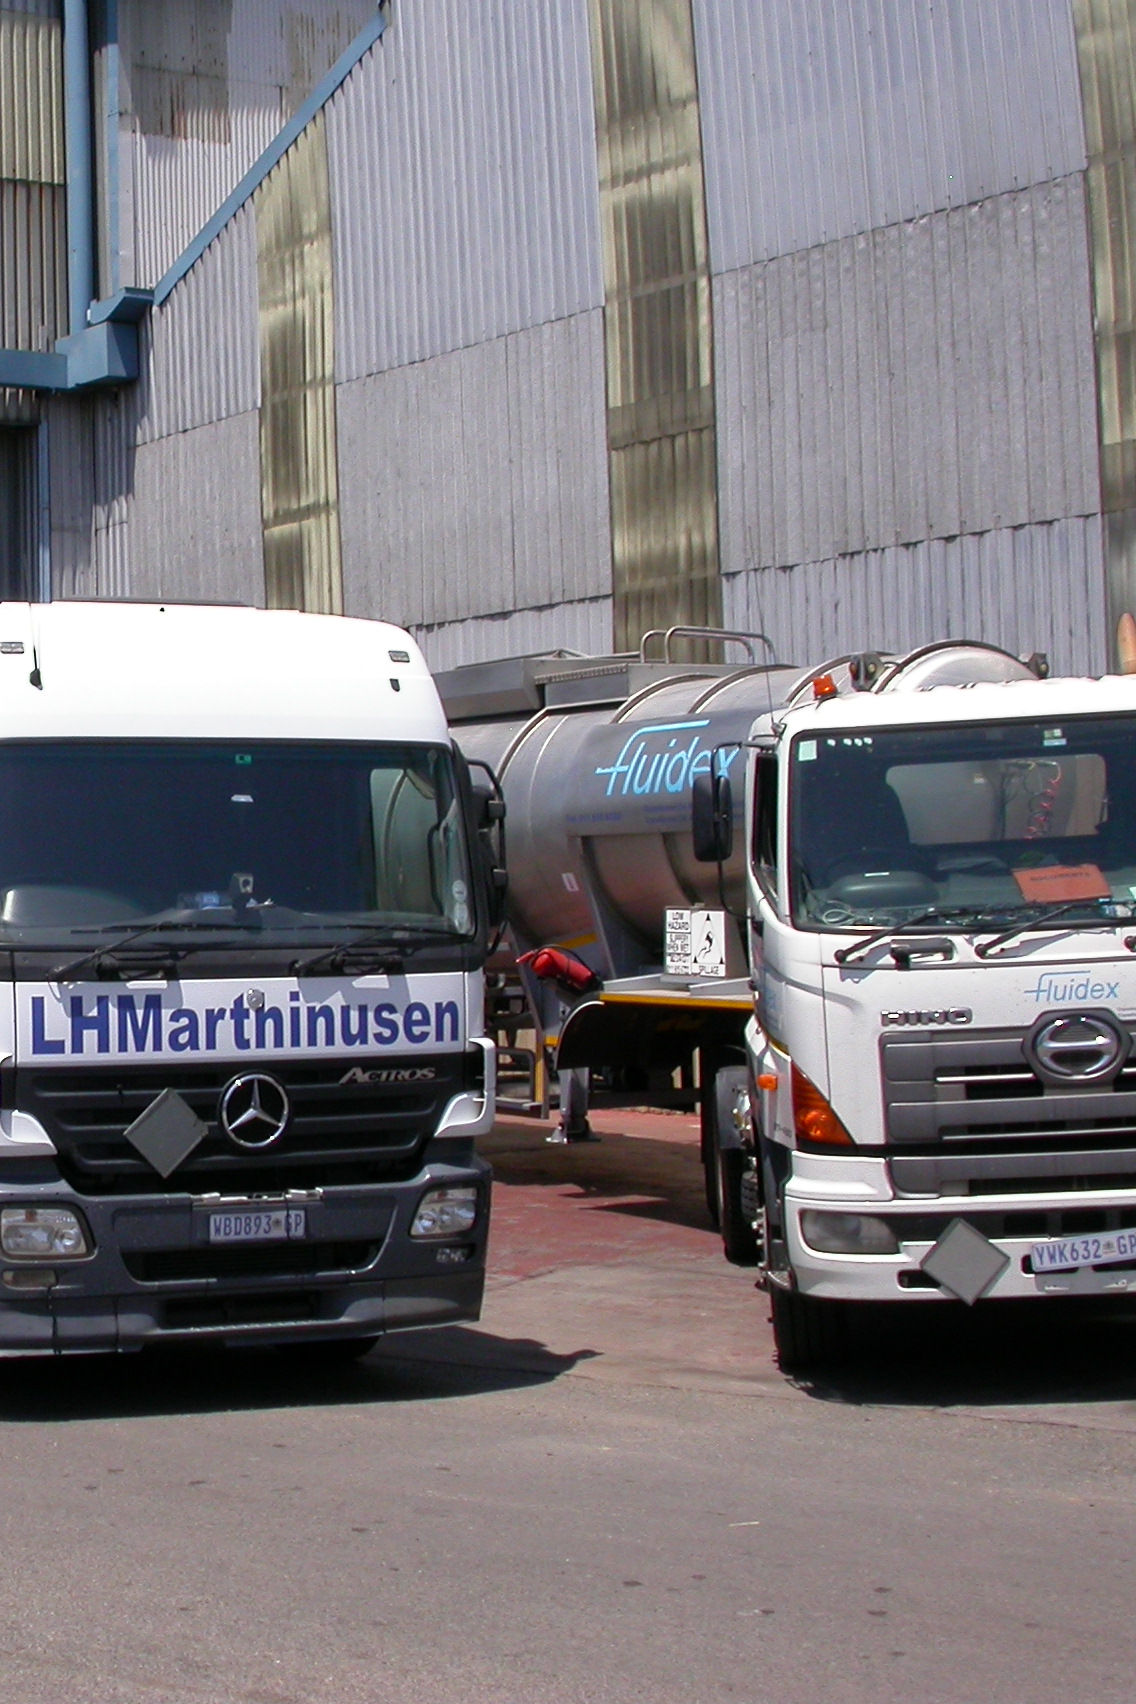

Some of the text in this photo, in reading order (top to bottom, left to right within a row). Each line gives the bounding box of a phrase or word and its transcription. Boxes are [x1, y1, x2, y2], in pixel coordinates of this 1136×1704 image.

[1024, 970, 1120, 1003] fluidex
[31, 990, 460, 1056] LHMarthinusen
[213, 1213, 273, 1238] WBD893
[1035, 1234, 1136, 1266] YWK632 GP
